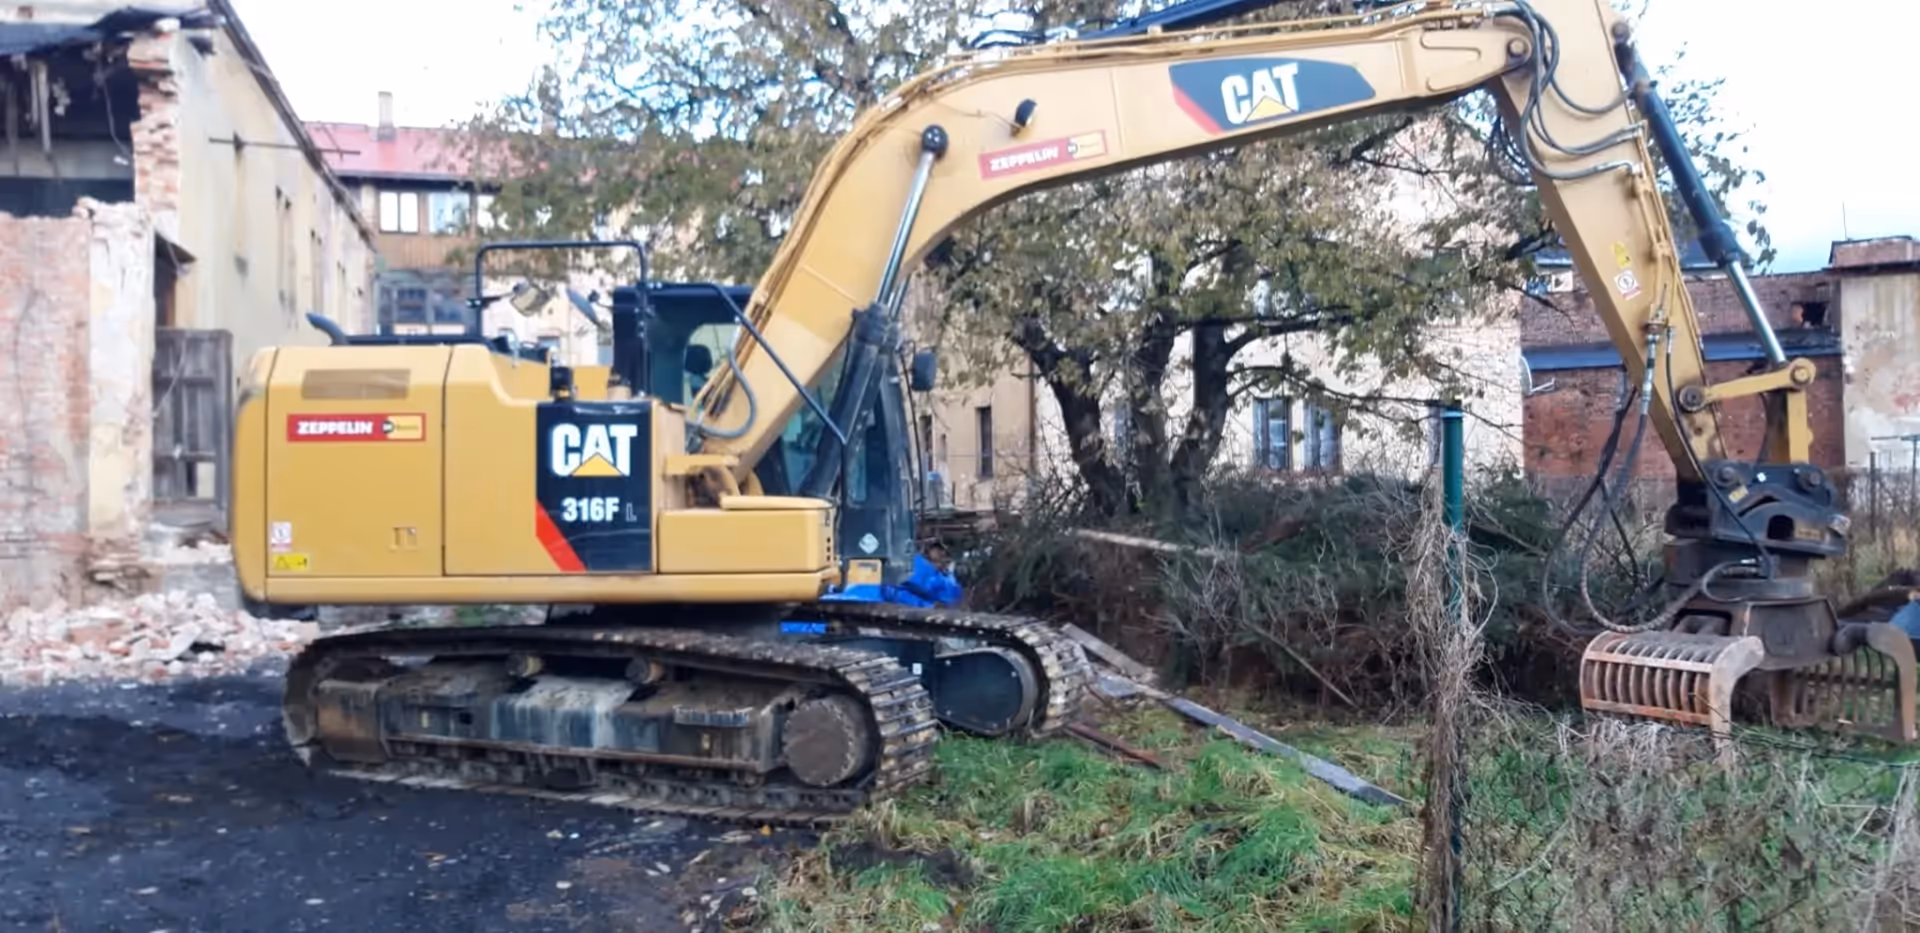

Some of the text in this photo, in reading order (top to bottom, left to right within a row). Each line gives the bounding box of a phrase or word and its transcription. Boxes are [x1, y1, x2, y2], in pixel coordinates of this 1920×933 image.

[1221, 62, 1299, 124] CAT
[990, 147, 1058, 171] ZEPPELIN
[297, 421, 373, 435] ZEPPELIN
[552, 423, 638, 476] CAT
[562, 497, 637, 522] 316F L
